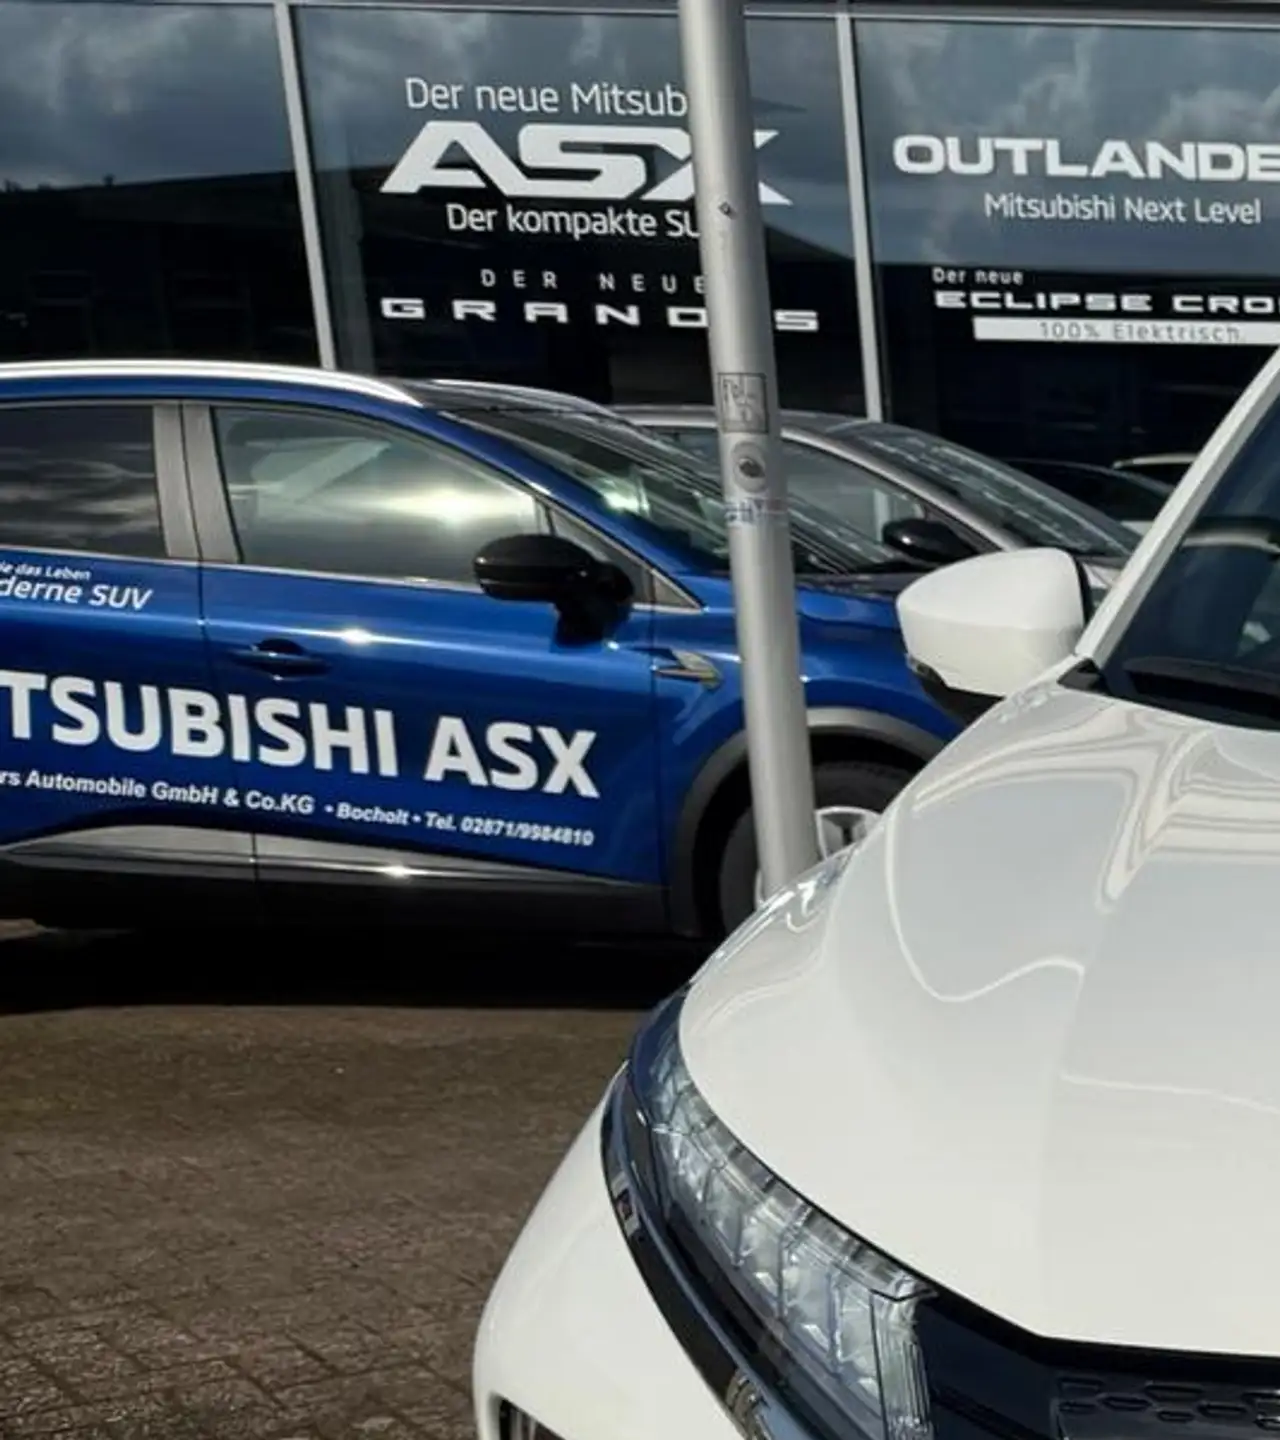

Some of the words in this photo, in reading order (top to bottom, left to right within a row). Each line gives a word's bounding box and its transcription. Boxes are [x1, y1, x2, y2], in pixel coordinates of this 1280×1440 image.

[404, 76, 464, 110] Der
[475, 84, 559, 114] neue
[570, 81, 690, 117] Mitsub
[446, 203, 499, 232] Der
[506, 204, 657, 240] kompakte
[984, 193, 1116, 220] Mitsubishi
[1124, 197, 1188, 223] Next
[1195, 198, 1262, 225] Level
[480, 268, 558, 289] DER
[599, 272, 708, 295] NEUE
[932, 267, 966, 285] Der
[975, 270, 1023, 286] neue
[380, 297, 819, 332] GRANDS
[934, 290, 1153, 313] ECLIPSE
[1038, 321, 1101, 339] 100%
[45, 565, 92, 581] Leben
[88, 583, 154, 611] SUV
[423, 715, 600, 798] ASX
[25, 769, 147, 799] Automobile
[151, 779, 217, 806] GmbH
[222, 788, 240, 808] &
[246, 789, 314, 814] Co.KG
[336, 802, 409, 826] Bocholt
[424, 812, 458, 832] Tel.
